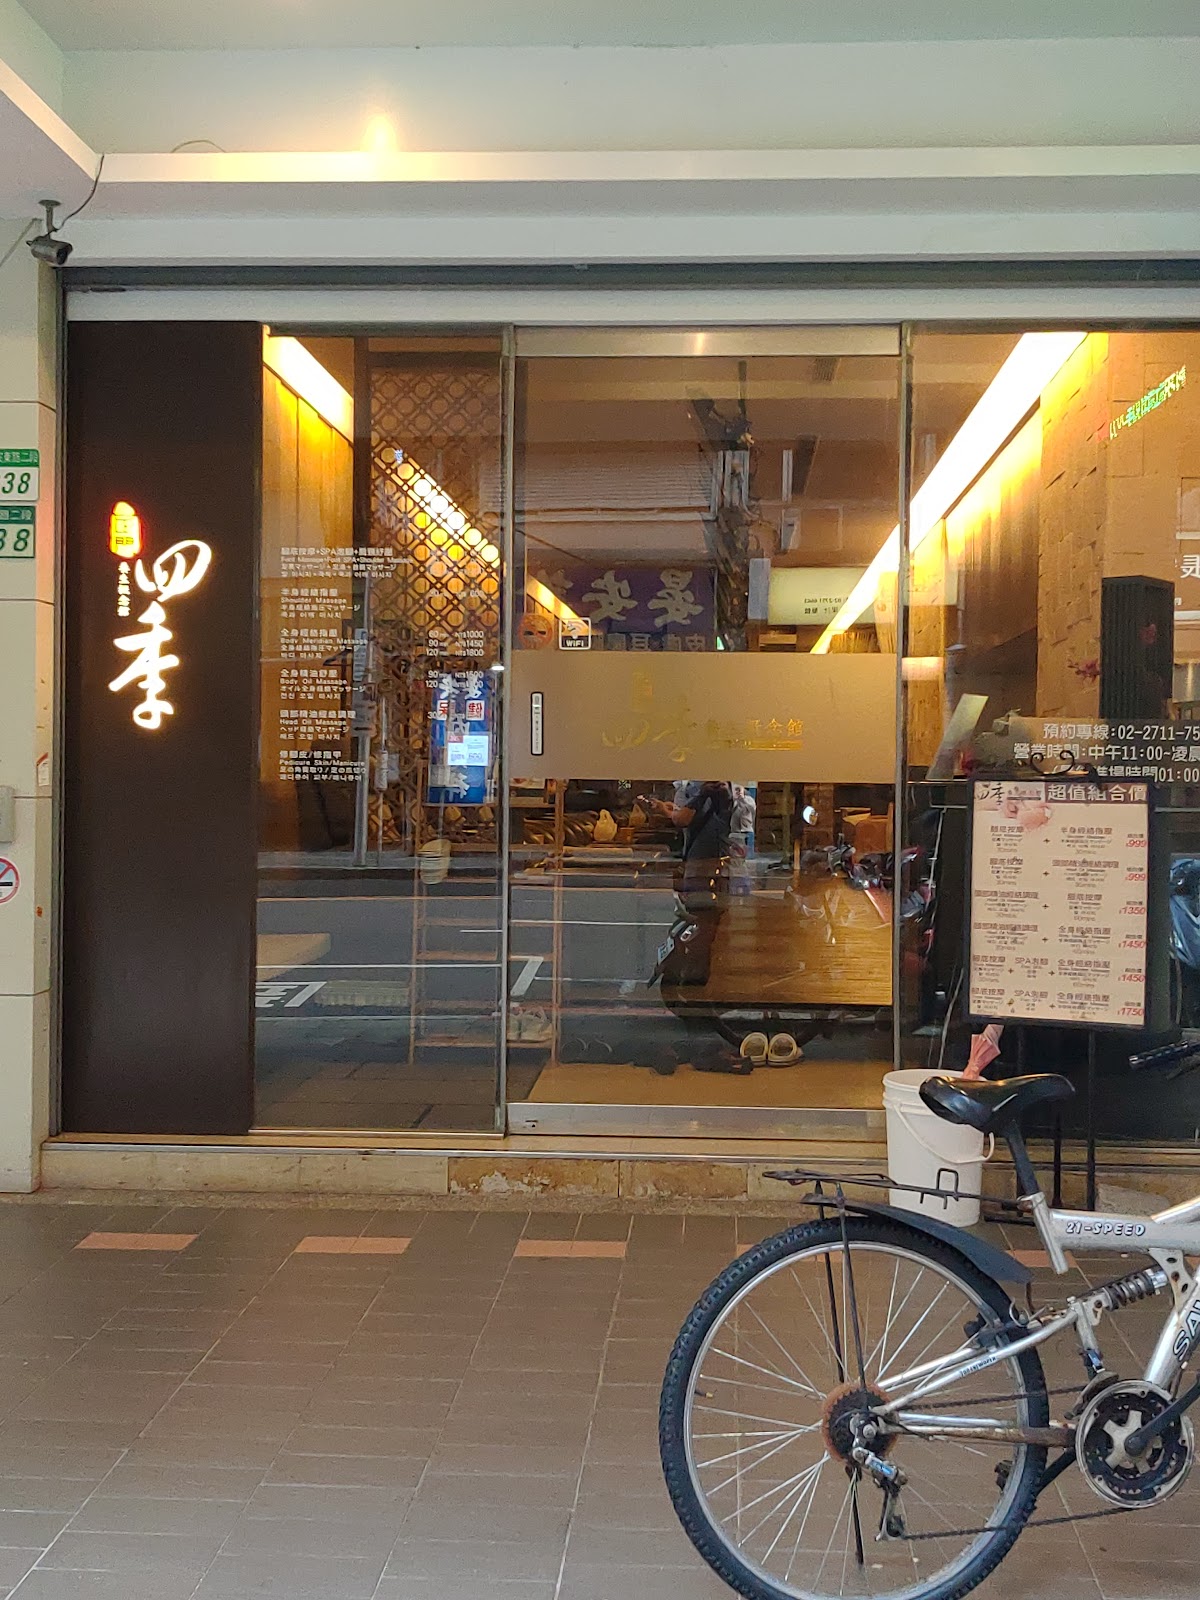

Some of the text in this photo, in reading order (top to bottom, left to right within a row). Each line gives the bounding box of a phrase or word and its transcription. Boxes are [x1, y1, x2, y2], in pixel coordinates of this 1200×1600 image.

[315, 597, 347, 605] Massage
[429, 639, 438, 647] 90
[426, 648, 438, 657] 120
[428, 670, 438, 679] 90
[315, 719, 347, 727] Massage
[1066, 1221, 1146, 1237] 21-SPEED
[1173, 1300, 1200, 1362] SA
